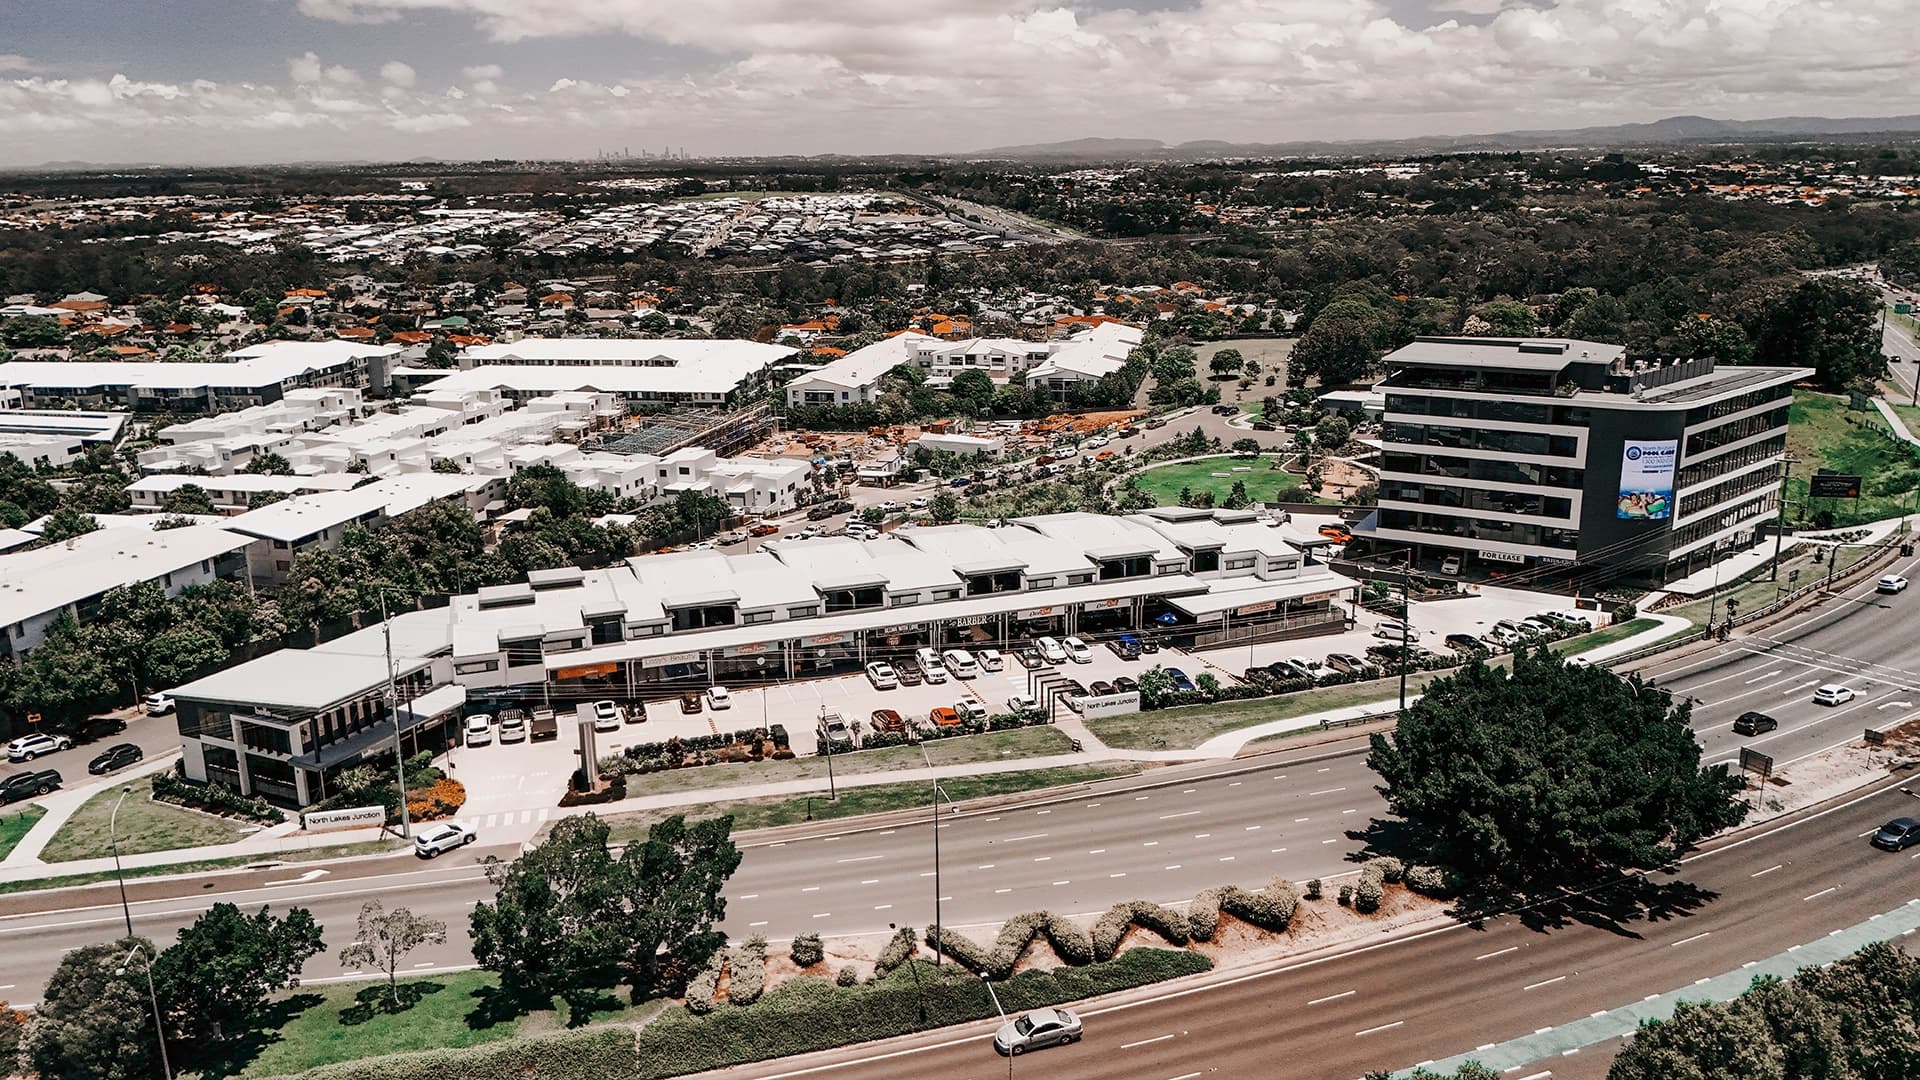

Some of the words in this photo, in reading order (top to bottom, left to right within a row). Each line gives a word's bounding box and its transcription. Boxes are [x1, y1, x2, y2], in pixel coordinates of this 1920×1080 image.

[1482, 551, 1497, 559] FOR
[1498, 553, 1521, 562] LEASE
[957, 614, 988, 628] BARBER
[1087, 702, 1101, 710] North
[1117, 698, 1138, 706] Junction
[309, 816, 329, 825] North
[329, 815, 351, 823] Lakes
[352, 812, 381, 821] Junction
